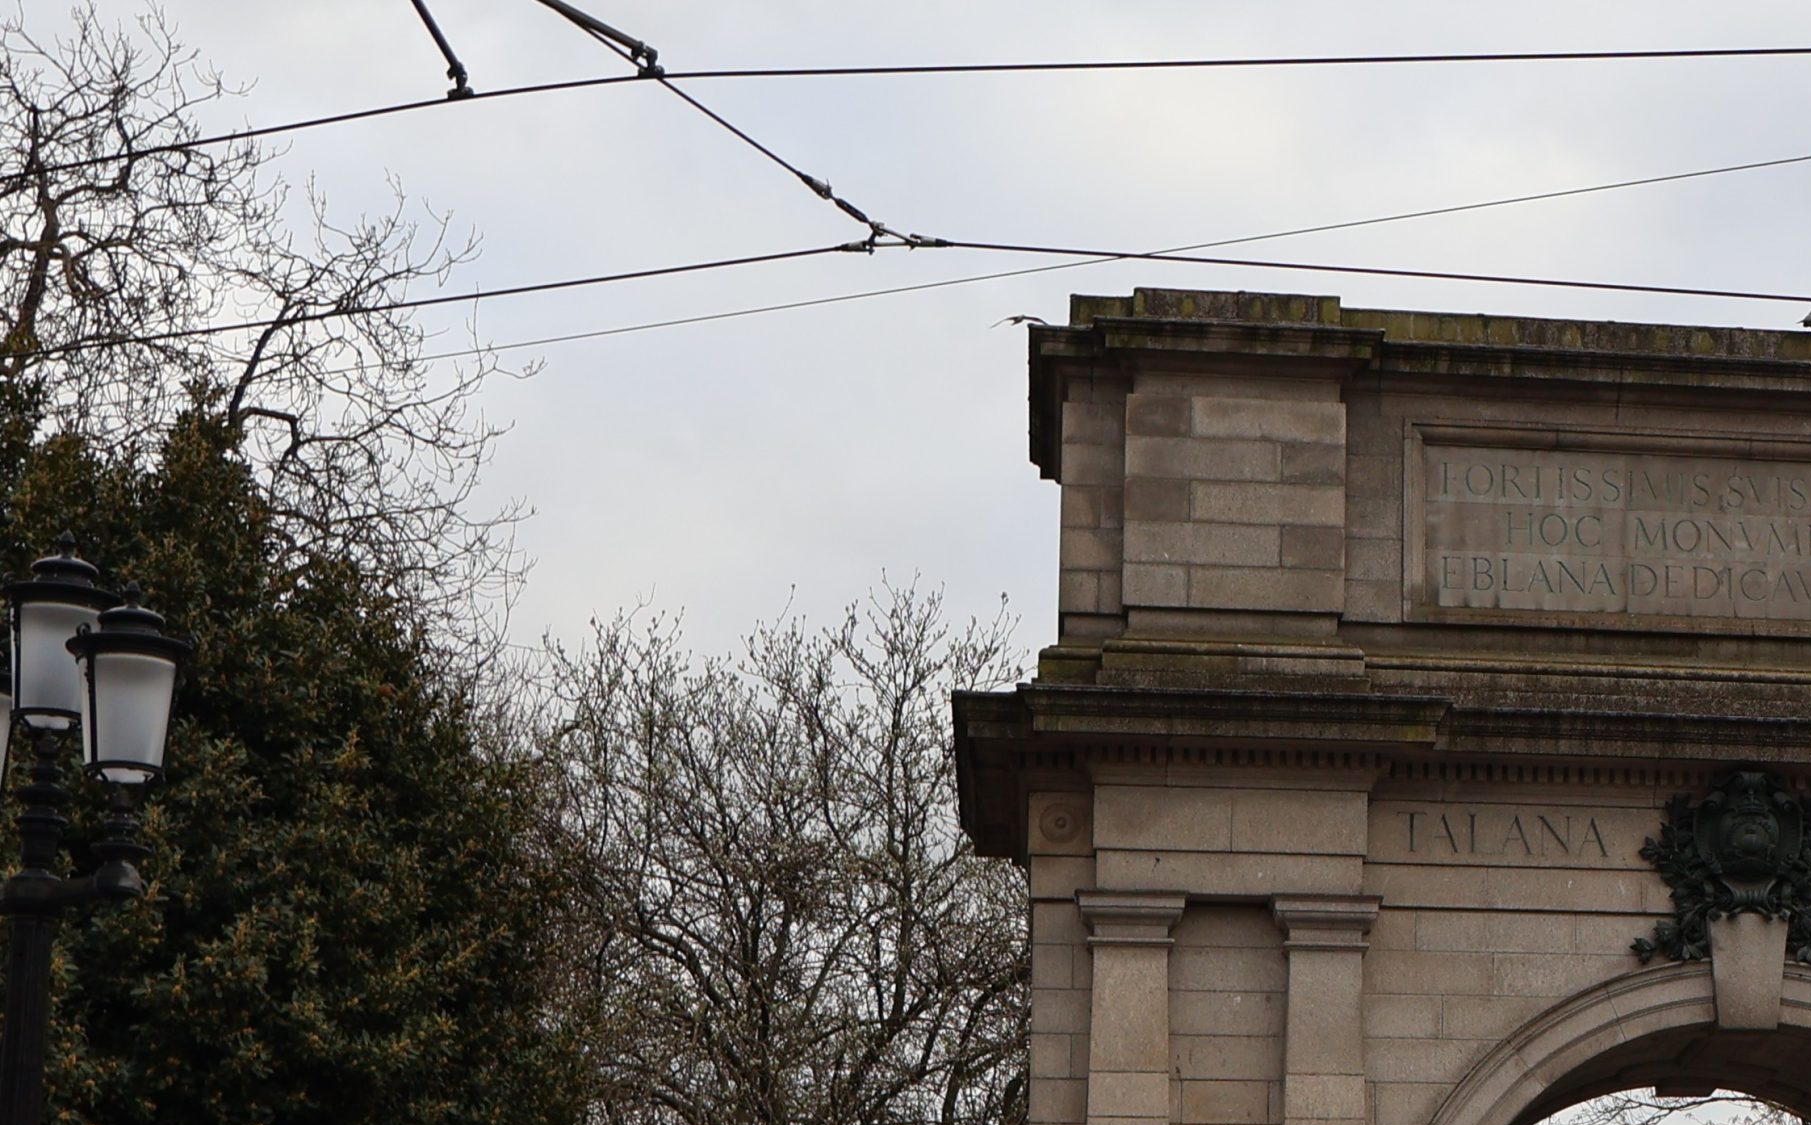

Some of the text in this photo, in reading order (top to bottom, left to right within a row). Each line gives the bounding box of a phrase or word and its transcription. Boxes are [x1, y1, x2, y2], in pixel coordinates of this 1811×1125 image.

[1505, 511, 1602, 548] HOC
[1441, 556, 1616, 596] EBLANA
[1396, 811, 1608, 858] TALANA
